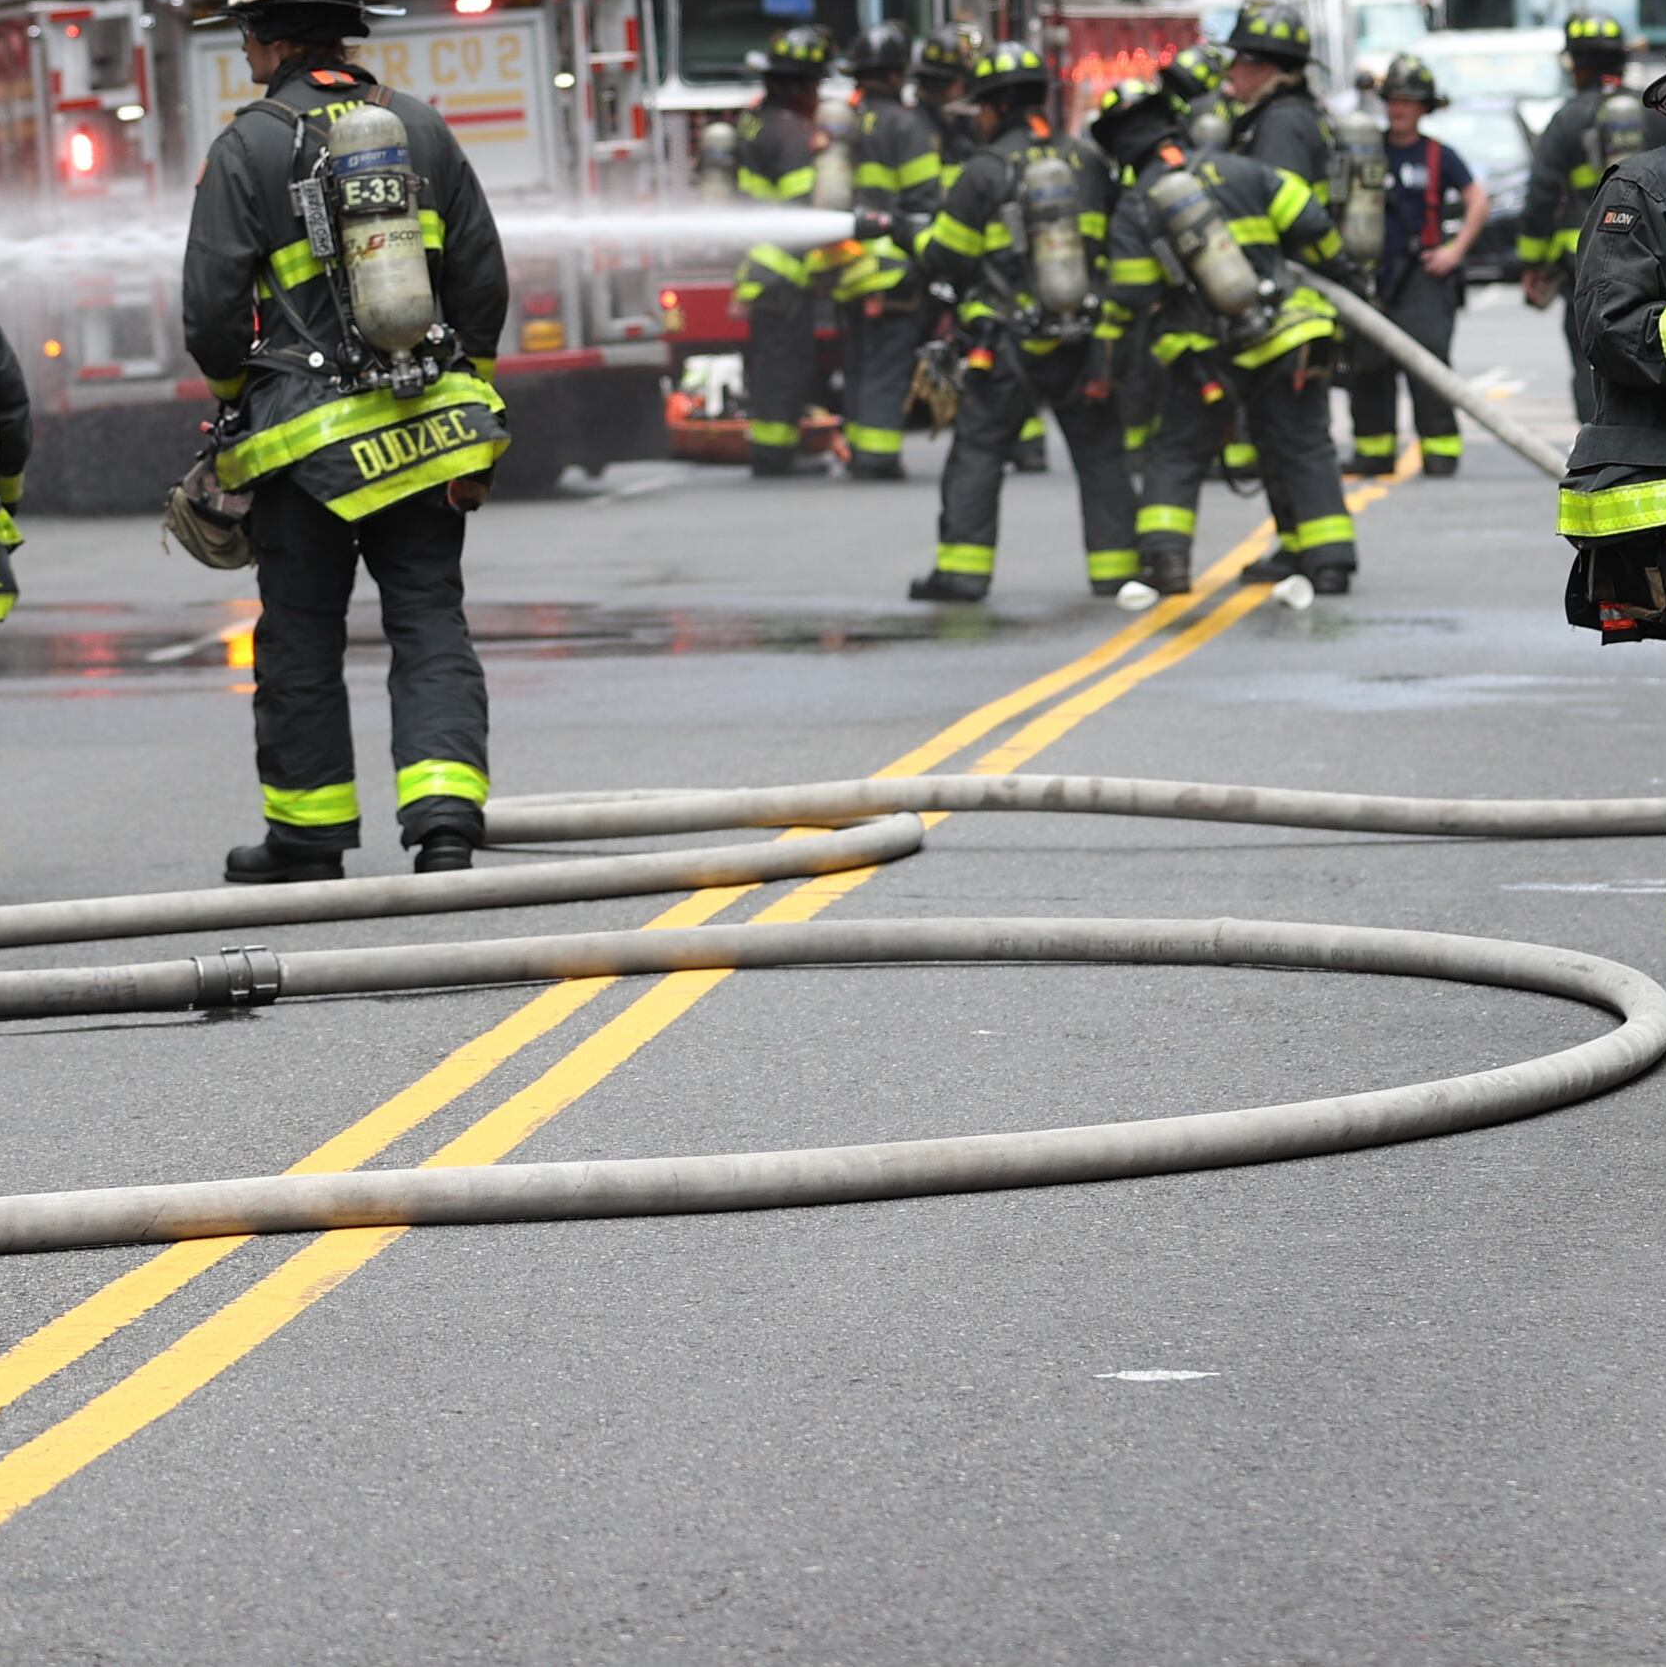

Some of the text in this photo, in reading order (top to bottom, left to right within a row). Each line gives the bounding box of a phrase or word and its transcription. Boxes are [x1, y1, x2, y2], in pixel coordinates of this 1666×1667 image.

[496, 33, 523, 80] 2
[345, 178, 402, 206] E-33
[350, 409, 478, 480] DUDZIEC
